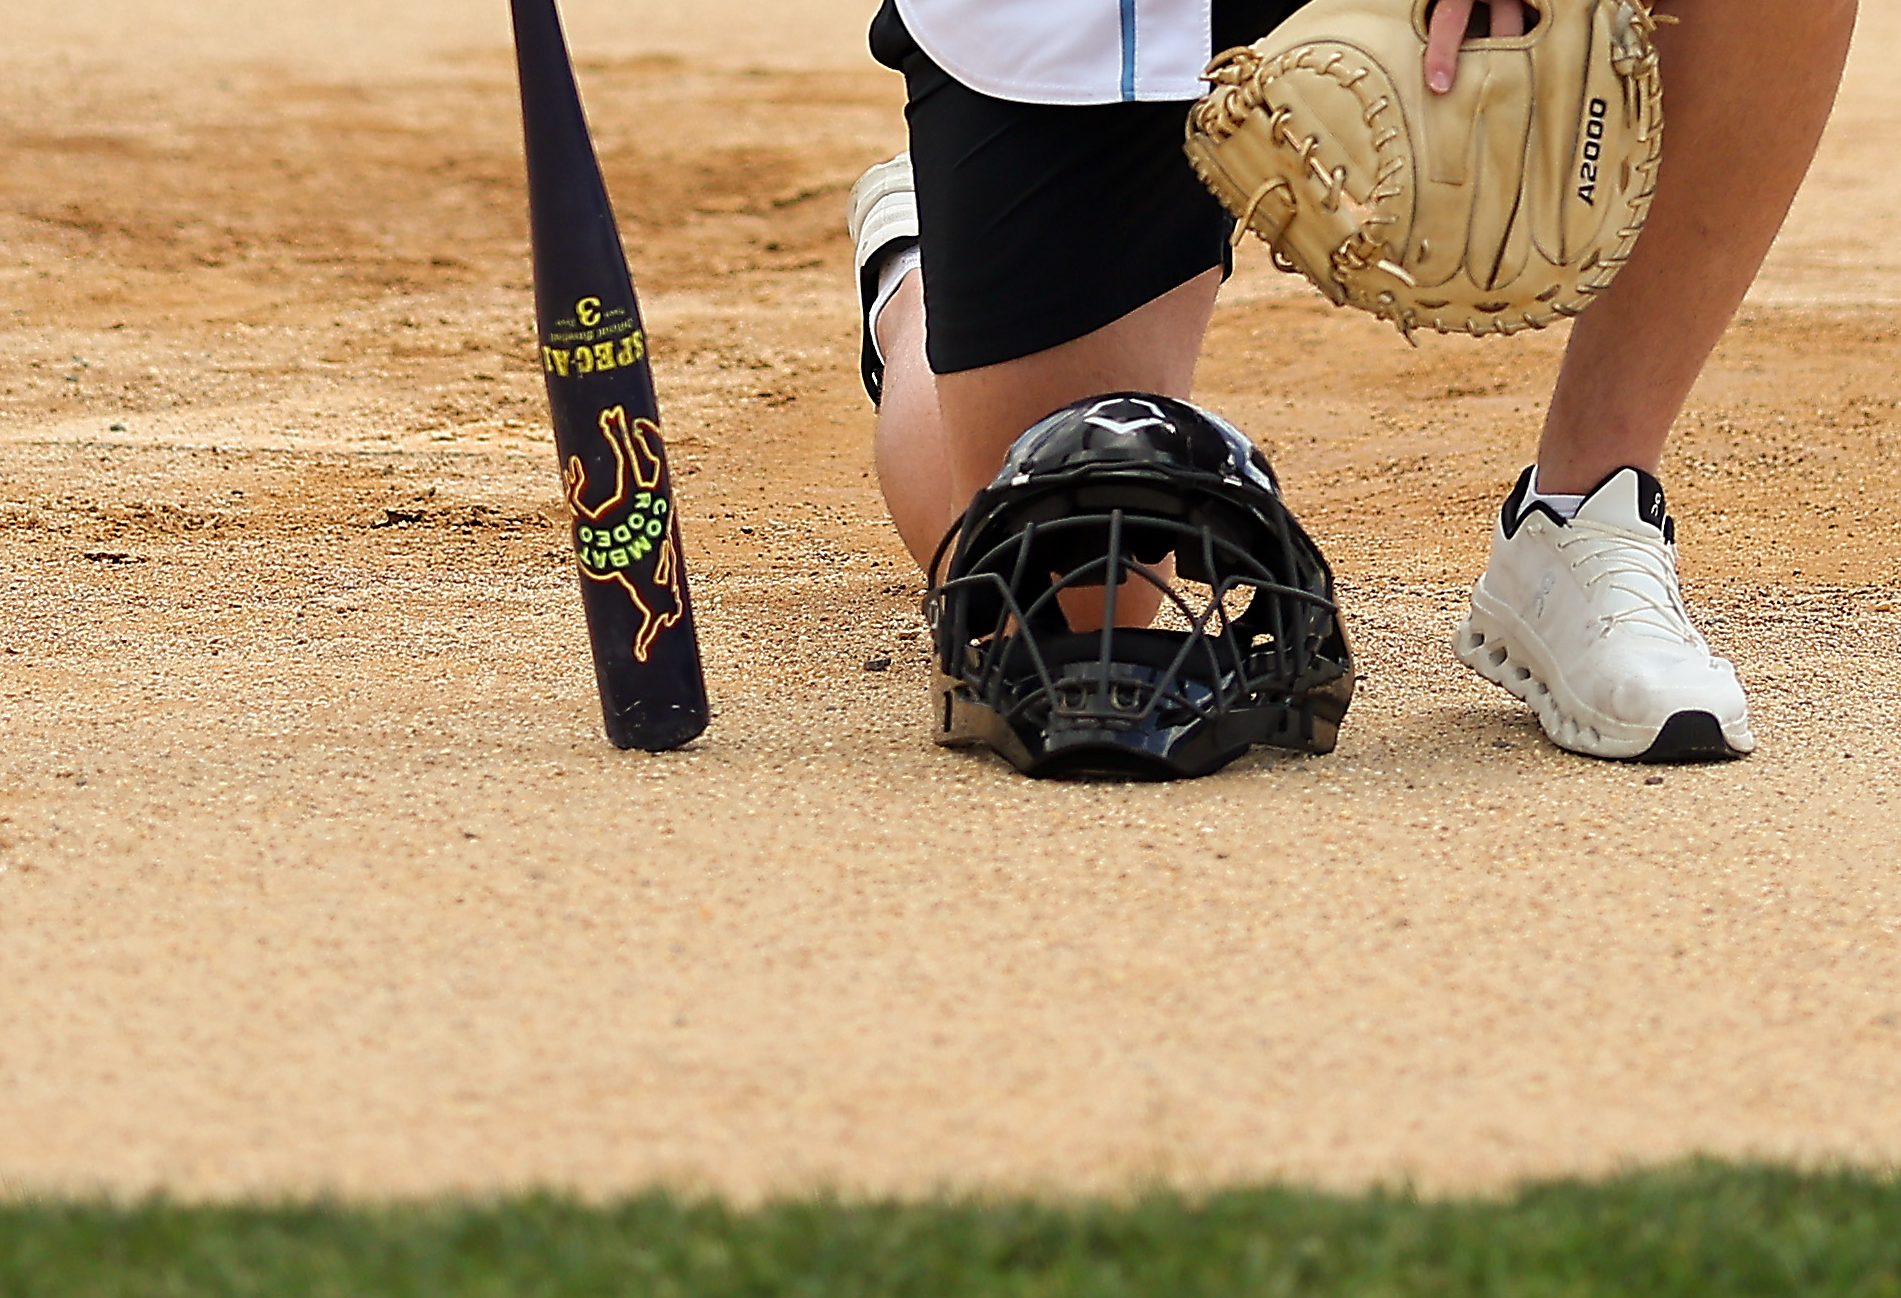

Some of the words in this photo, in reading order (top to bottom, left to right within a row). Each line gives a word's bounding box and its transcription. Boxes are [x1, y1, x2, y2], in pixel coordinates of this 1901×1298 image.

[1577, 97, 1607, 206] A2000
[575, 297, 601, 326] 3
[578, 492, 652, 548] RODEO
[579, 497, 667, 569] COMBAT
